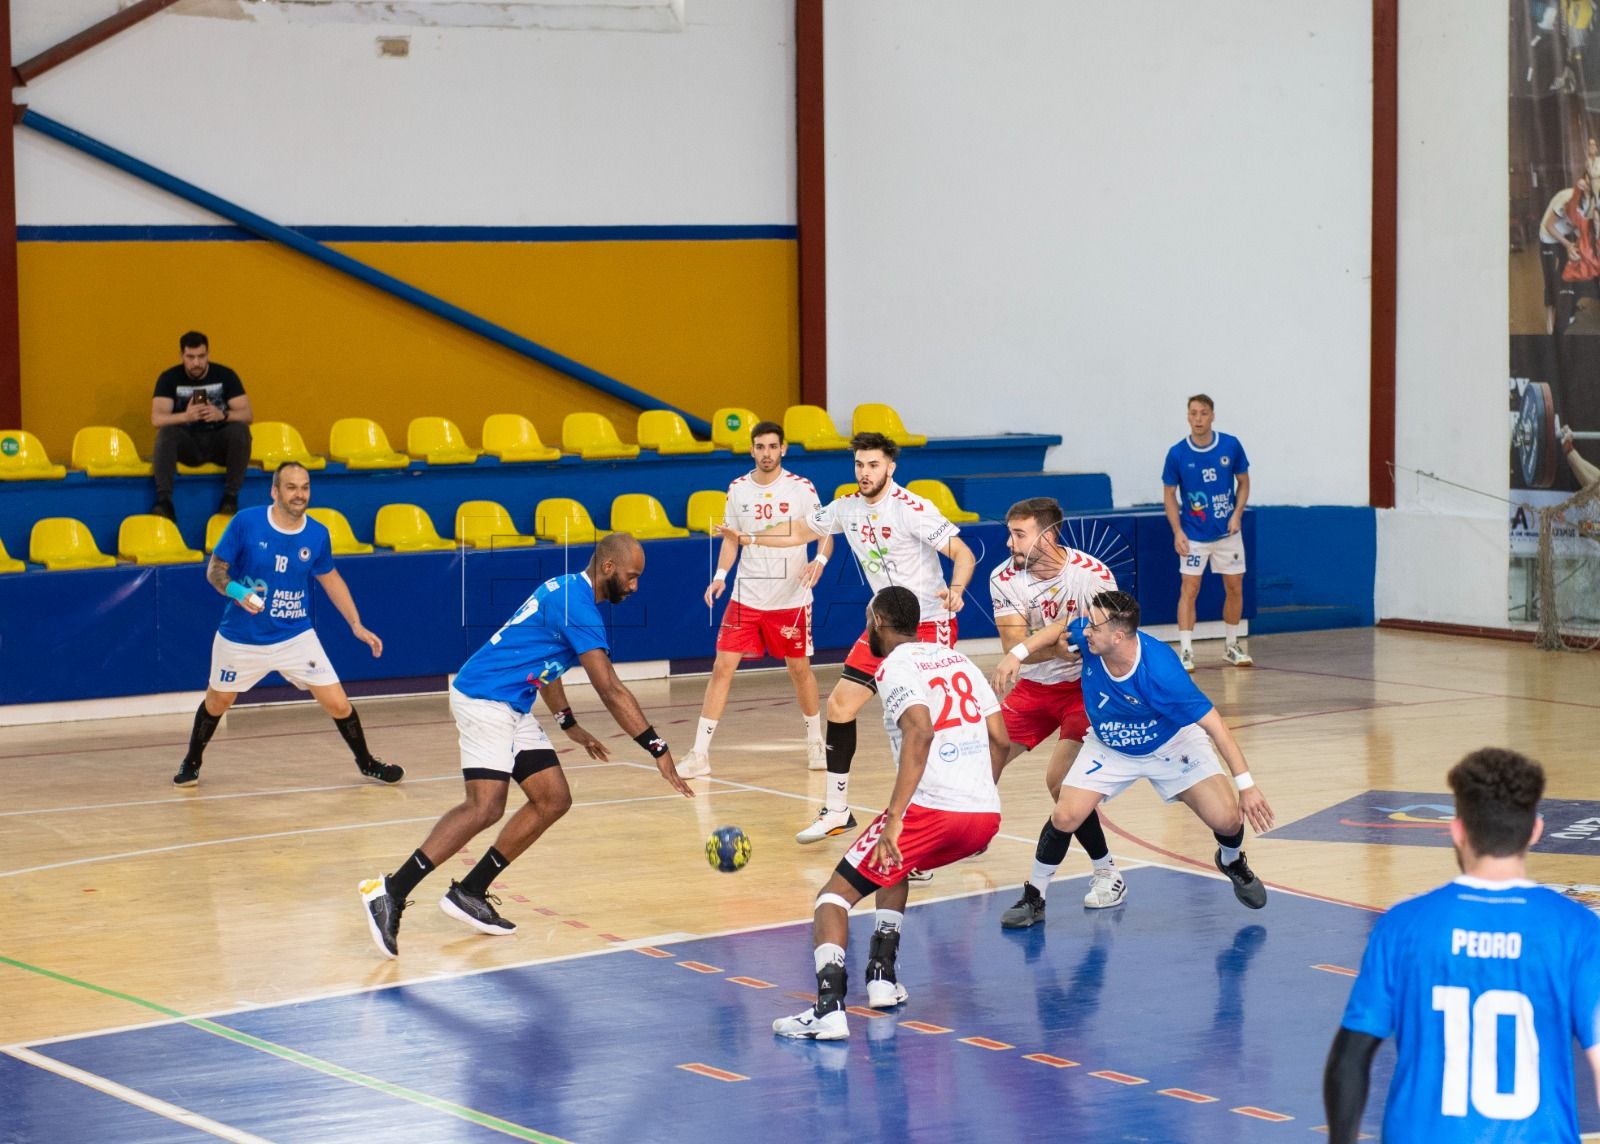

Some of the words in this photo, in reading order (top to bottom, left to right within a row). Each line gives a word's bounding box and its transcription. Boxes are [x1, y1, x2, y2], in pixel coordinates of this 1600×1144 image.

[1202, 468, 1217, 482] 26
[754, 504, 773, 520] 30
[861, 525, 876, 545] 56
[275, 554, 288, 573] 18
[1186, 555, 1200, 567] 26
[269, 608, 307, 619] CAPITAL
[219, 669, 237, 682] 18
[928, 671, 982, 732] 28
[1098, 691, 1110, 709] 7
[1085, 759, 1103, 775] 7
[1451, 928, 1522, 959] PEDRO
[1432, 985, 1540, 1120] 10
